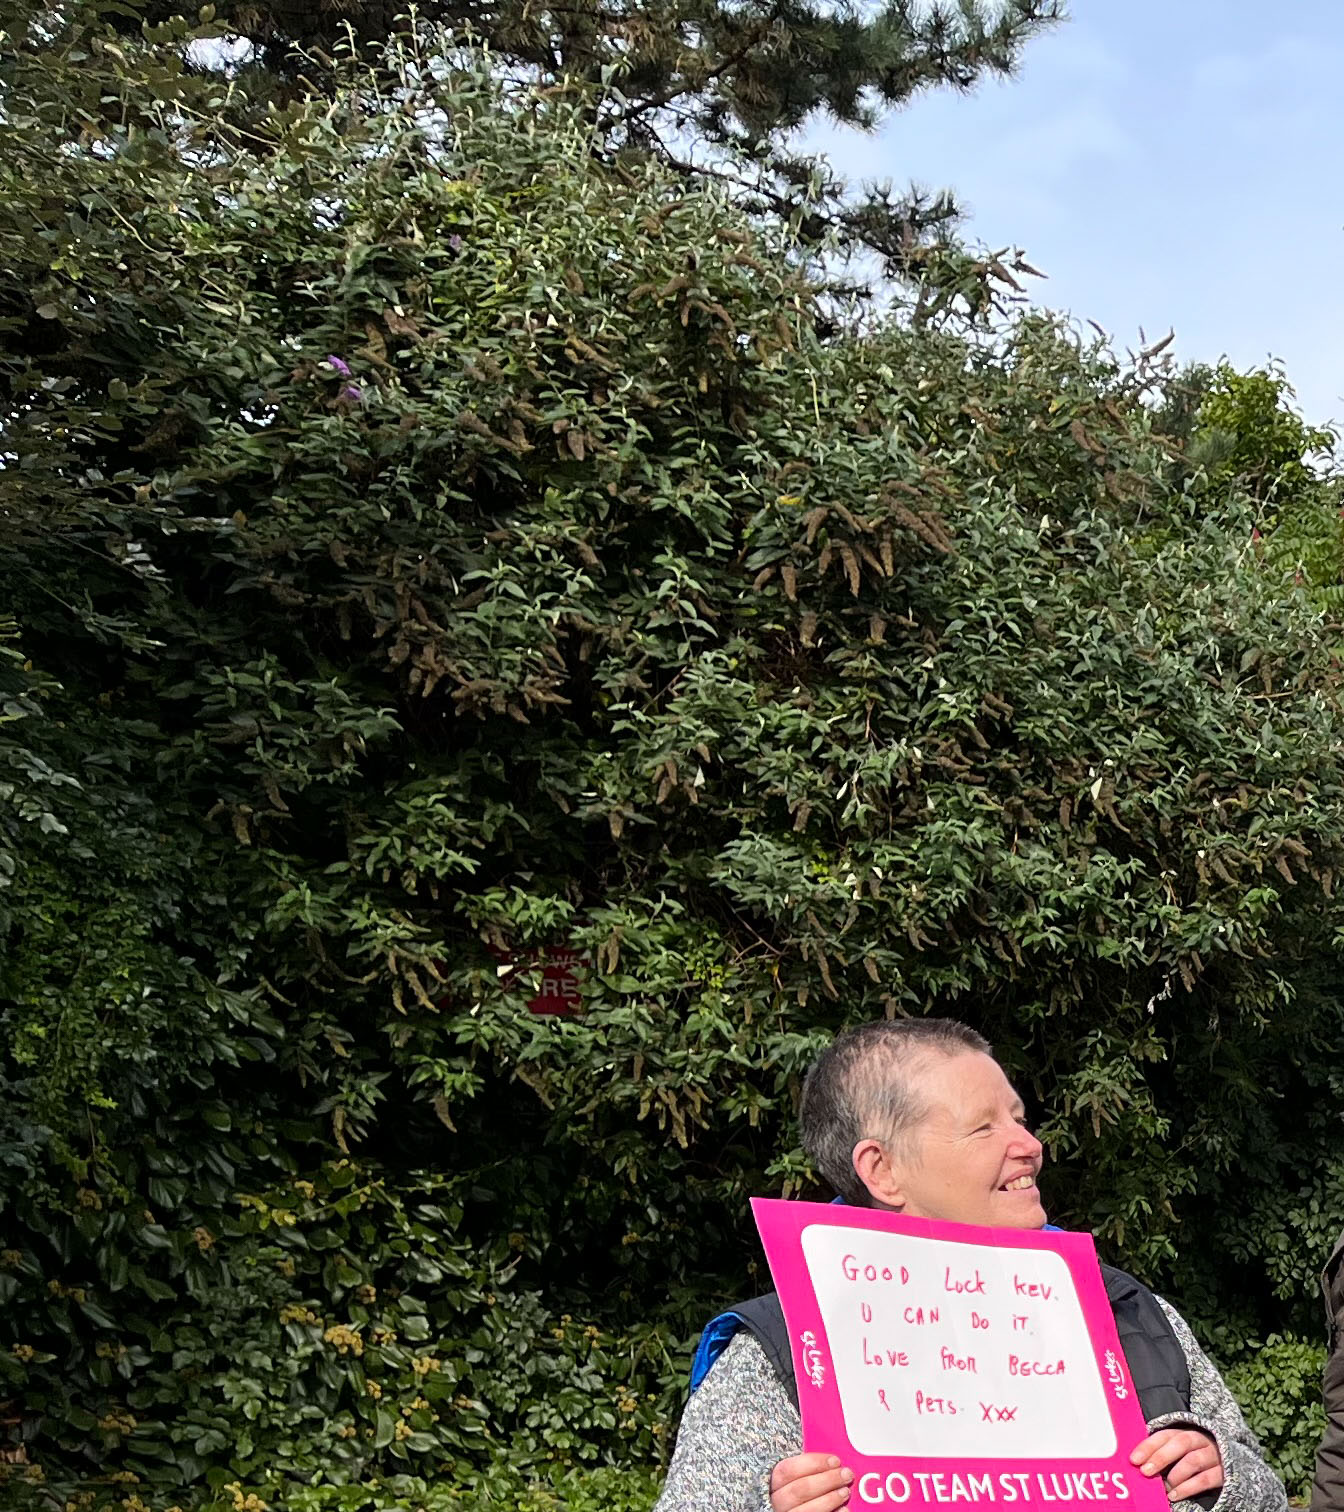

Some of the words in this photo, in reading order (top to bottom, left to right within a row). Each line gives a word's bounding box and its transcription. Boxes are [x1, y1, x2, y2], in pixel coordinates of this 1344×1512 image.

[842, 1254, 910, 1286] GOOD
[861, 1302, 872, 1323] U
[903, 1306, 940, 1325] CAN
[863, 1337, 910, 1367] LOVE
[1008, 1353, 1066, 1377] BECCA
[859, 1473, 912, 1504] GO
[914, 1472, 996, 1503] TEAM
[999, 1472, 1033, 1503] ST
[1037, 1470, 1130, 1502] LUKE'S
